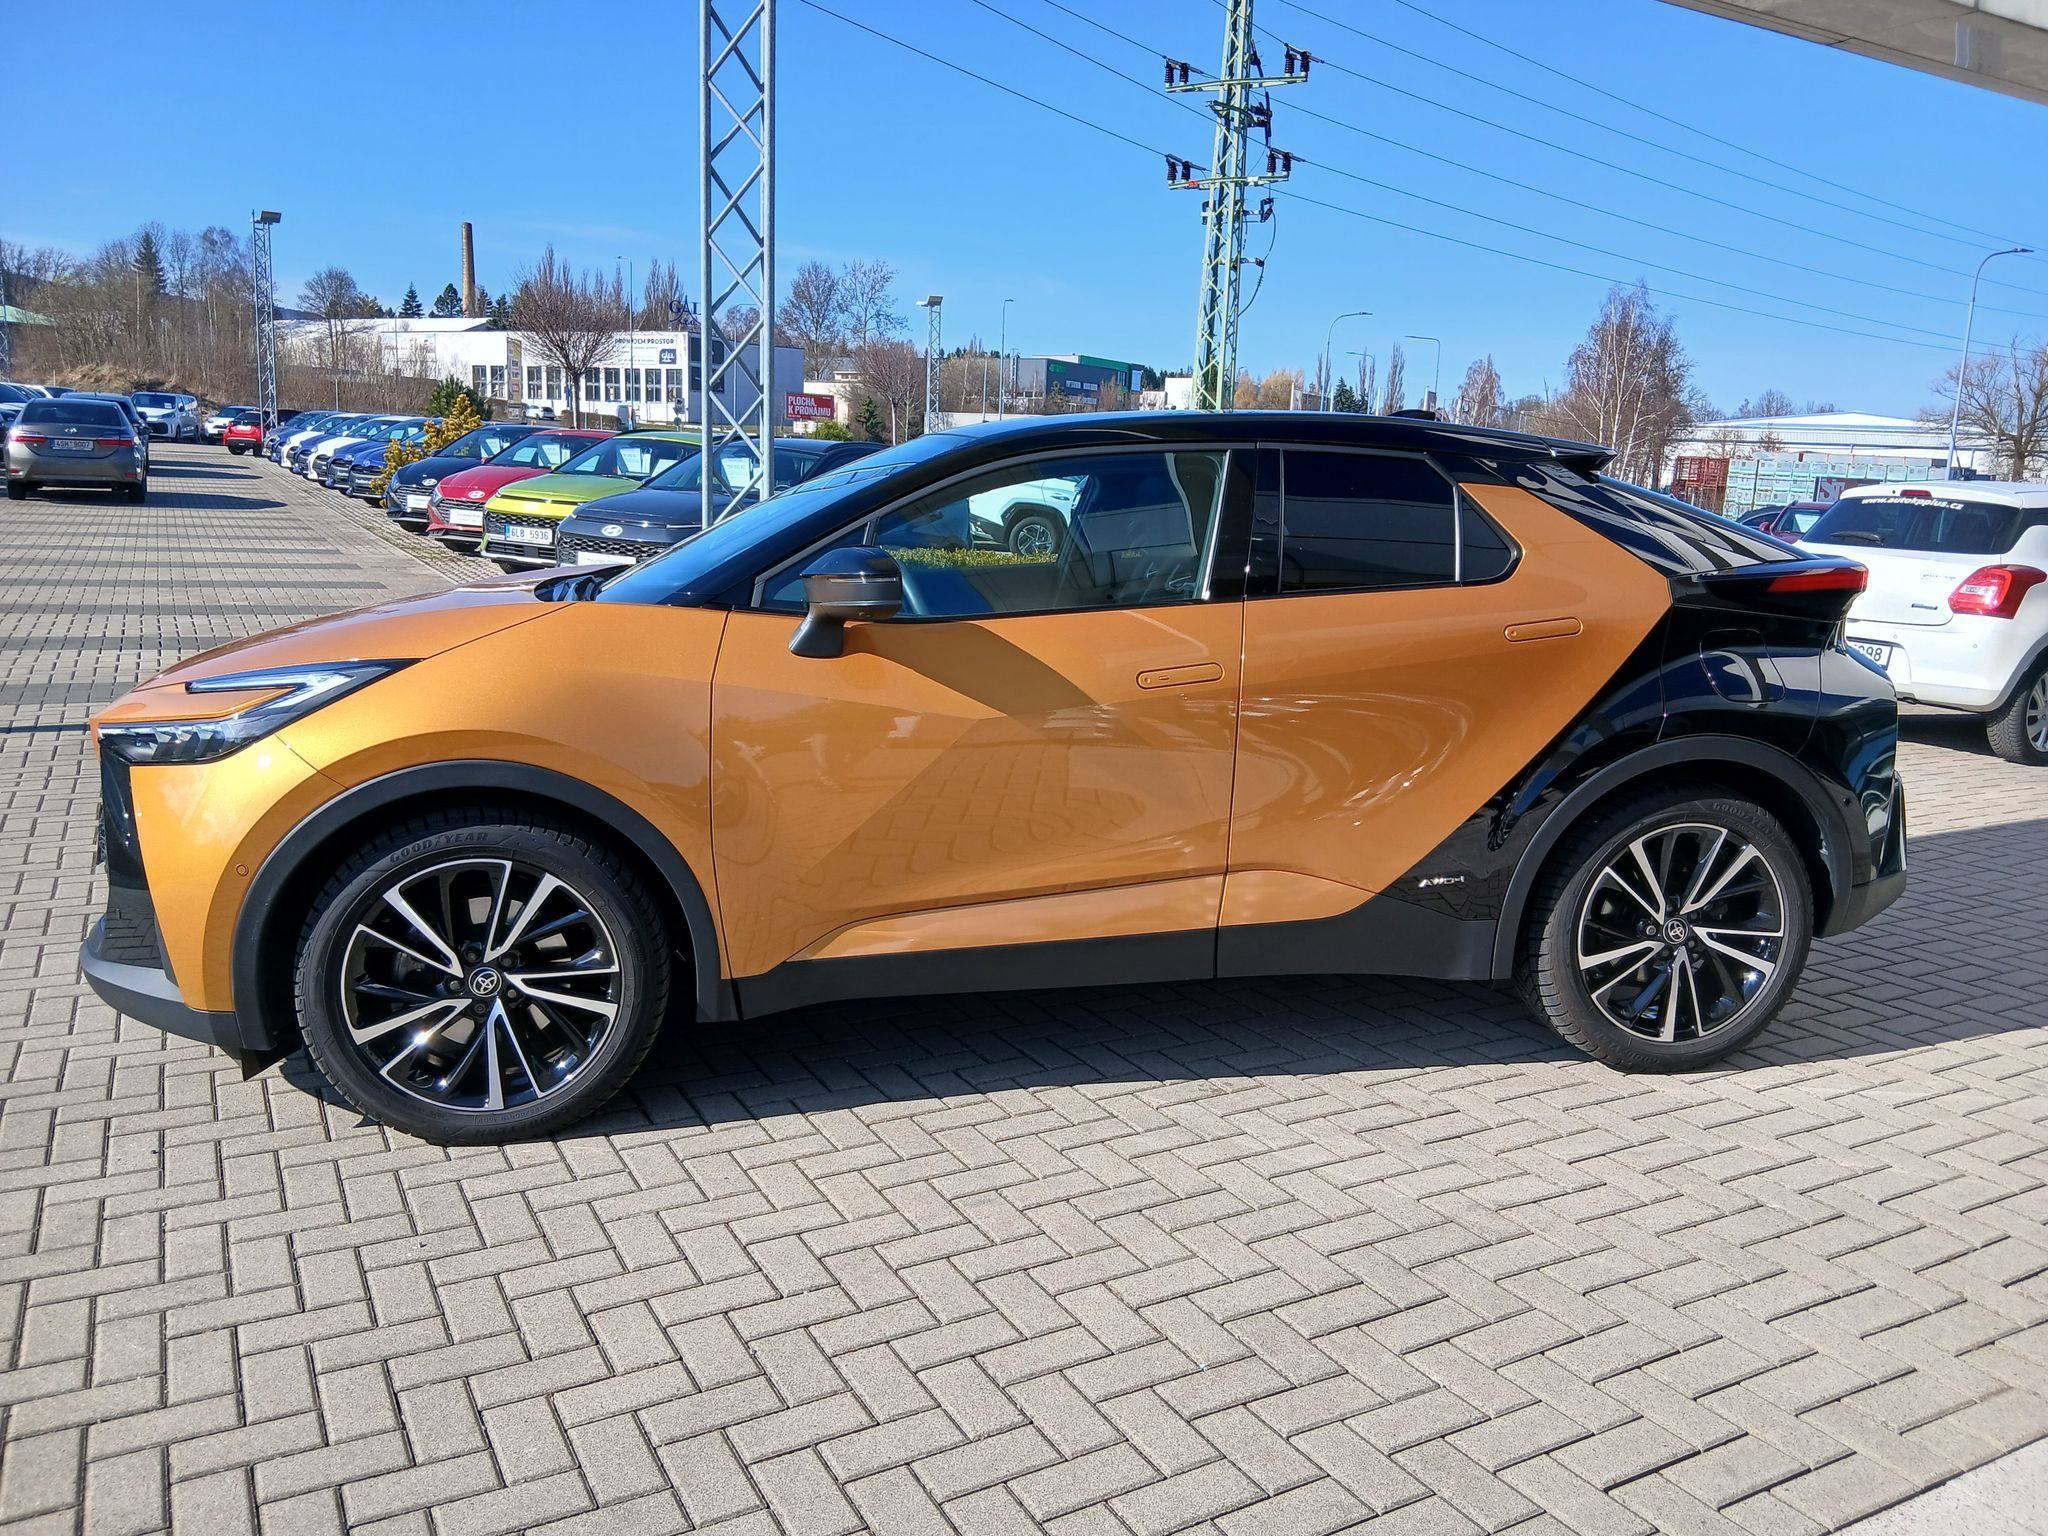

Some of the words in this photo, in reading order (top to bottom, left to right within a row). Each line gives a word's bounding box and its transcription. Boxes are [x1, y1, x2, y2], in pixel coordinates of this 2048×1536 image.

[788, 406, 794, 415] K
[1861, 498, 1964, 510] www.autokpplus.cz
[511, 527, 525, 538] 6L8
[529, 530, 549, 540] 5936
